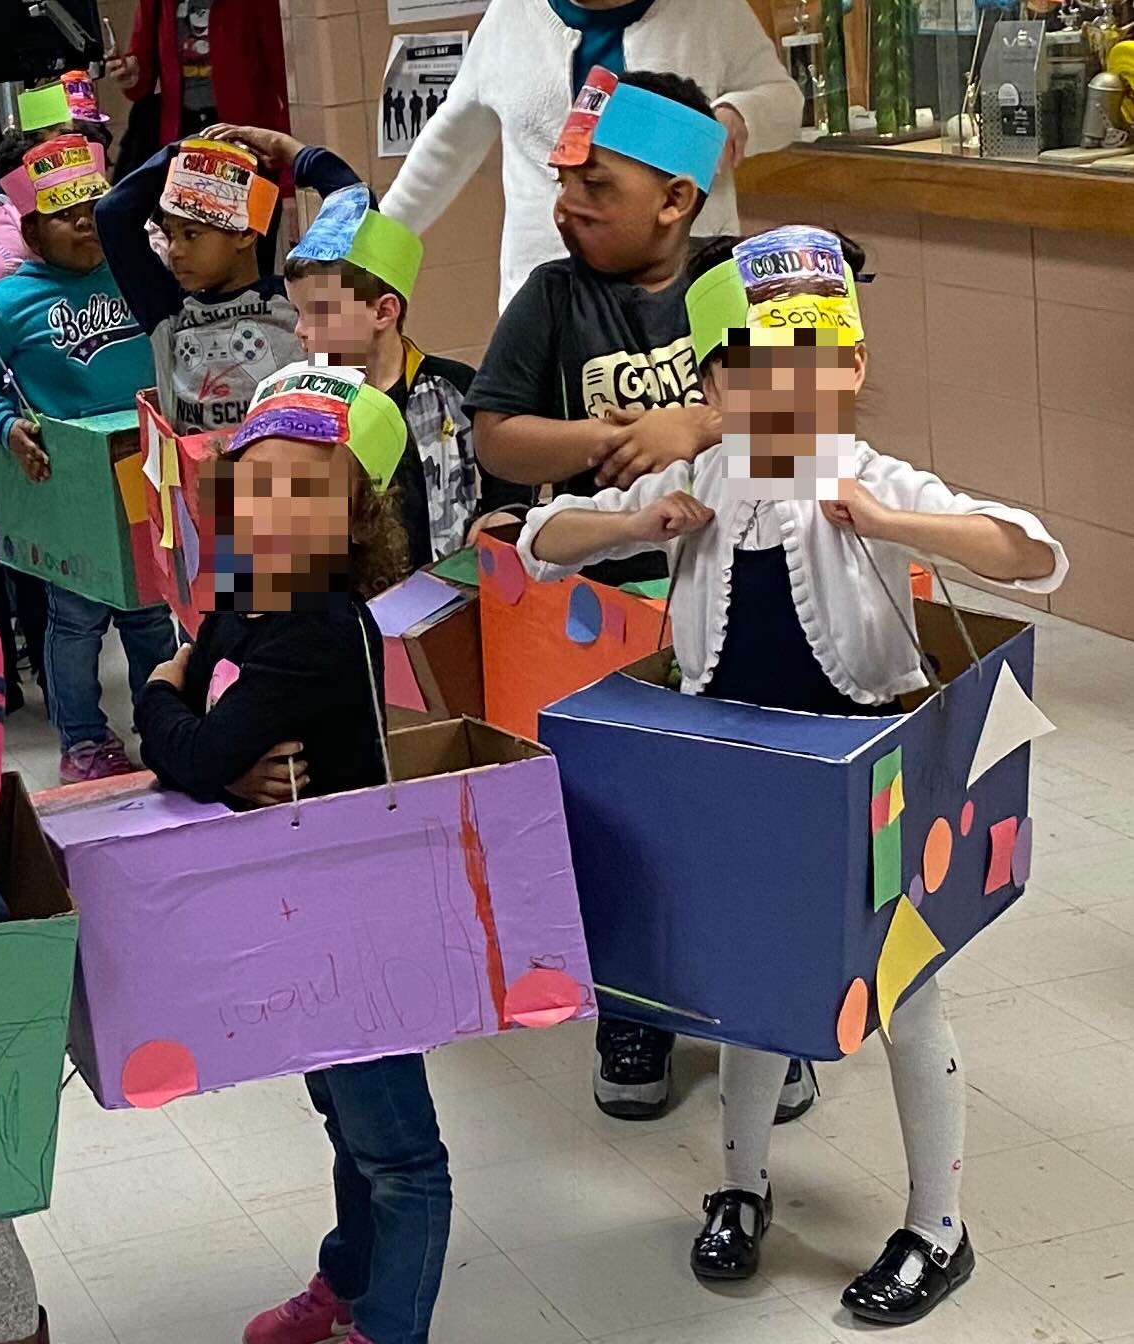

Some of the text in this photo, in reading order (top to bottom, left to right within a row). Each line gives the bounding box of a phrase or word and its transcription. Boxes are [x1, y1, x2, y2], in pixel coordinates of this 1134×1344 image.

[769, 301, 852, 328] Sophia
[618, 347, 699, 400] GAME
[177, 397, 204, 425] NEW
